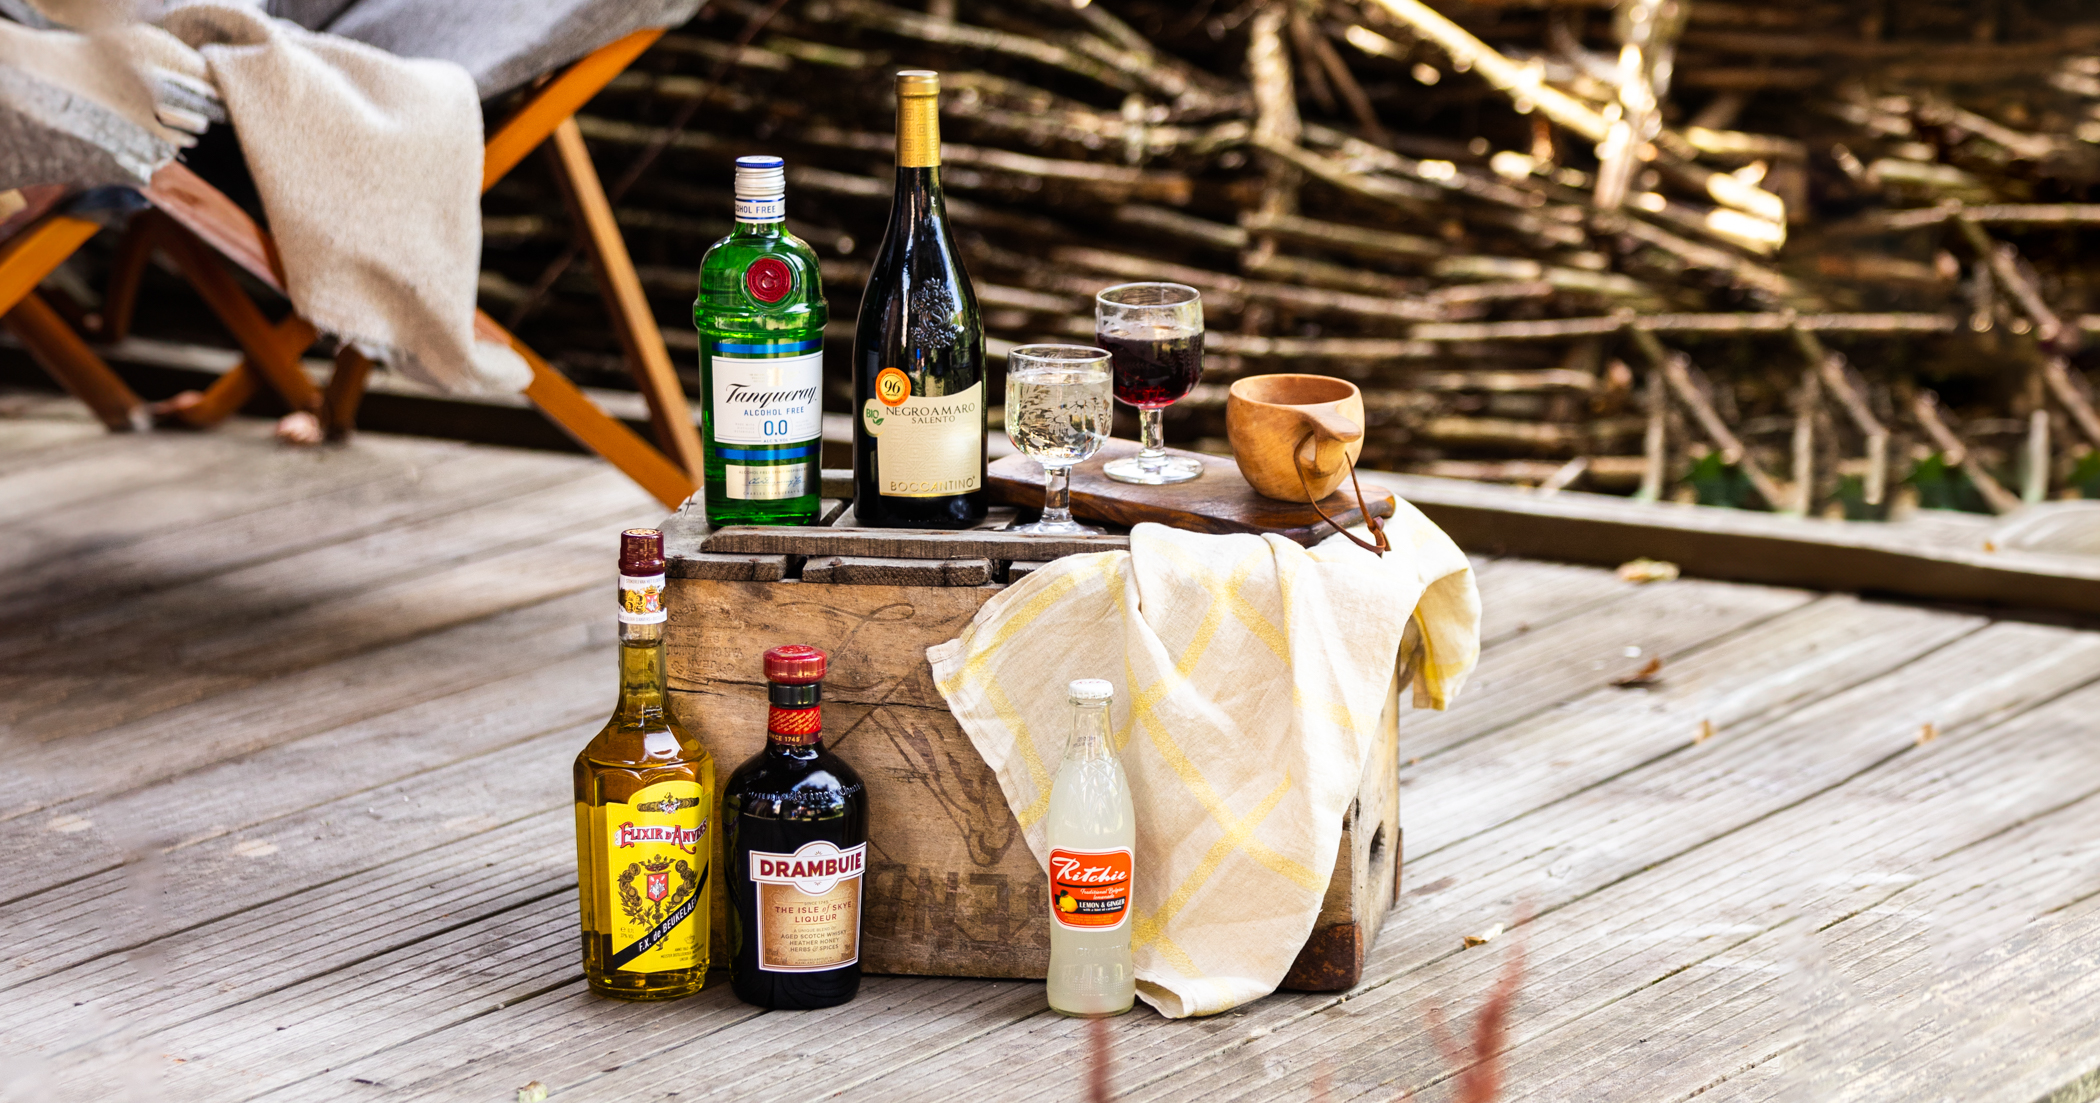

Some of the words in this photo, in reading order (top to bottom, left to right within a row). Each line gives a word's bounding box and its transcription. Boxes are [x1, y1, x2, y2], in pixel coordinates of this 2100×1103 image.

[756, 205, 776, 214] FREE
[884, 379, 901, 394] 96
[726, 383, 817, 409] Tanqueray
[743, 409, 782, 417] ALCOHOL
[786, 406, 805, 415] FREE
[866, 408, 879, 419] BIO
[886, 402, 975, 416] NEGROAMARO
[912, 416, 955, 424] SALENTO
[763, 419, 788, 437] 0.0
[891, 478, 974, 492] BOCCANTINO
[619, 821, 663, 848] ELIXIR
[760, 851, 862, 878] DRAMBUIE
[1052, 856, 1127, 882] Ritchie
[775, 906, 794, 914] THE
[797, 906, 819, 914] ISLE
[821, 903, 831, 914] of
[832, 901, 852, 911] SKYE
[1106, 898, 1125, 907] GINGER
[795, 913, 837, 923] LIQUEUR
[638, 937, 652, 952] F.X.
[653, 928, 662, 941] de
[827, 929, 847, 937] WHISKY
